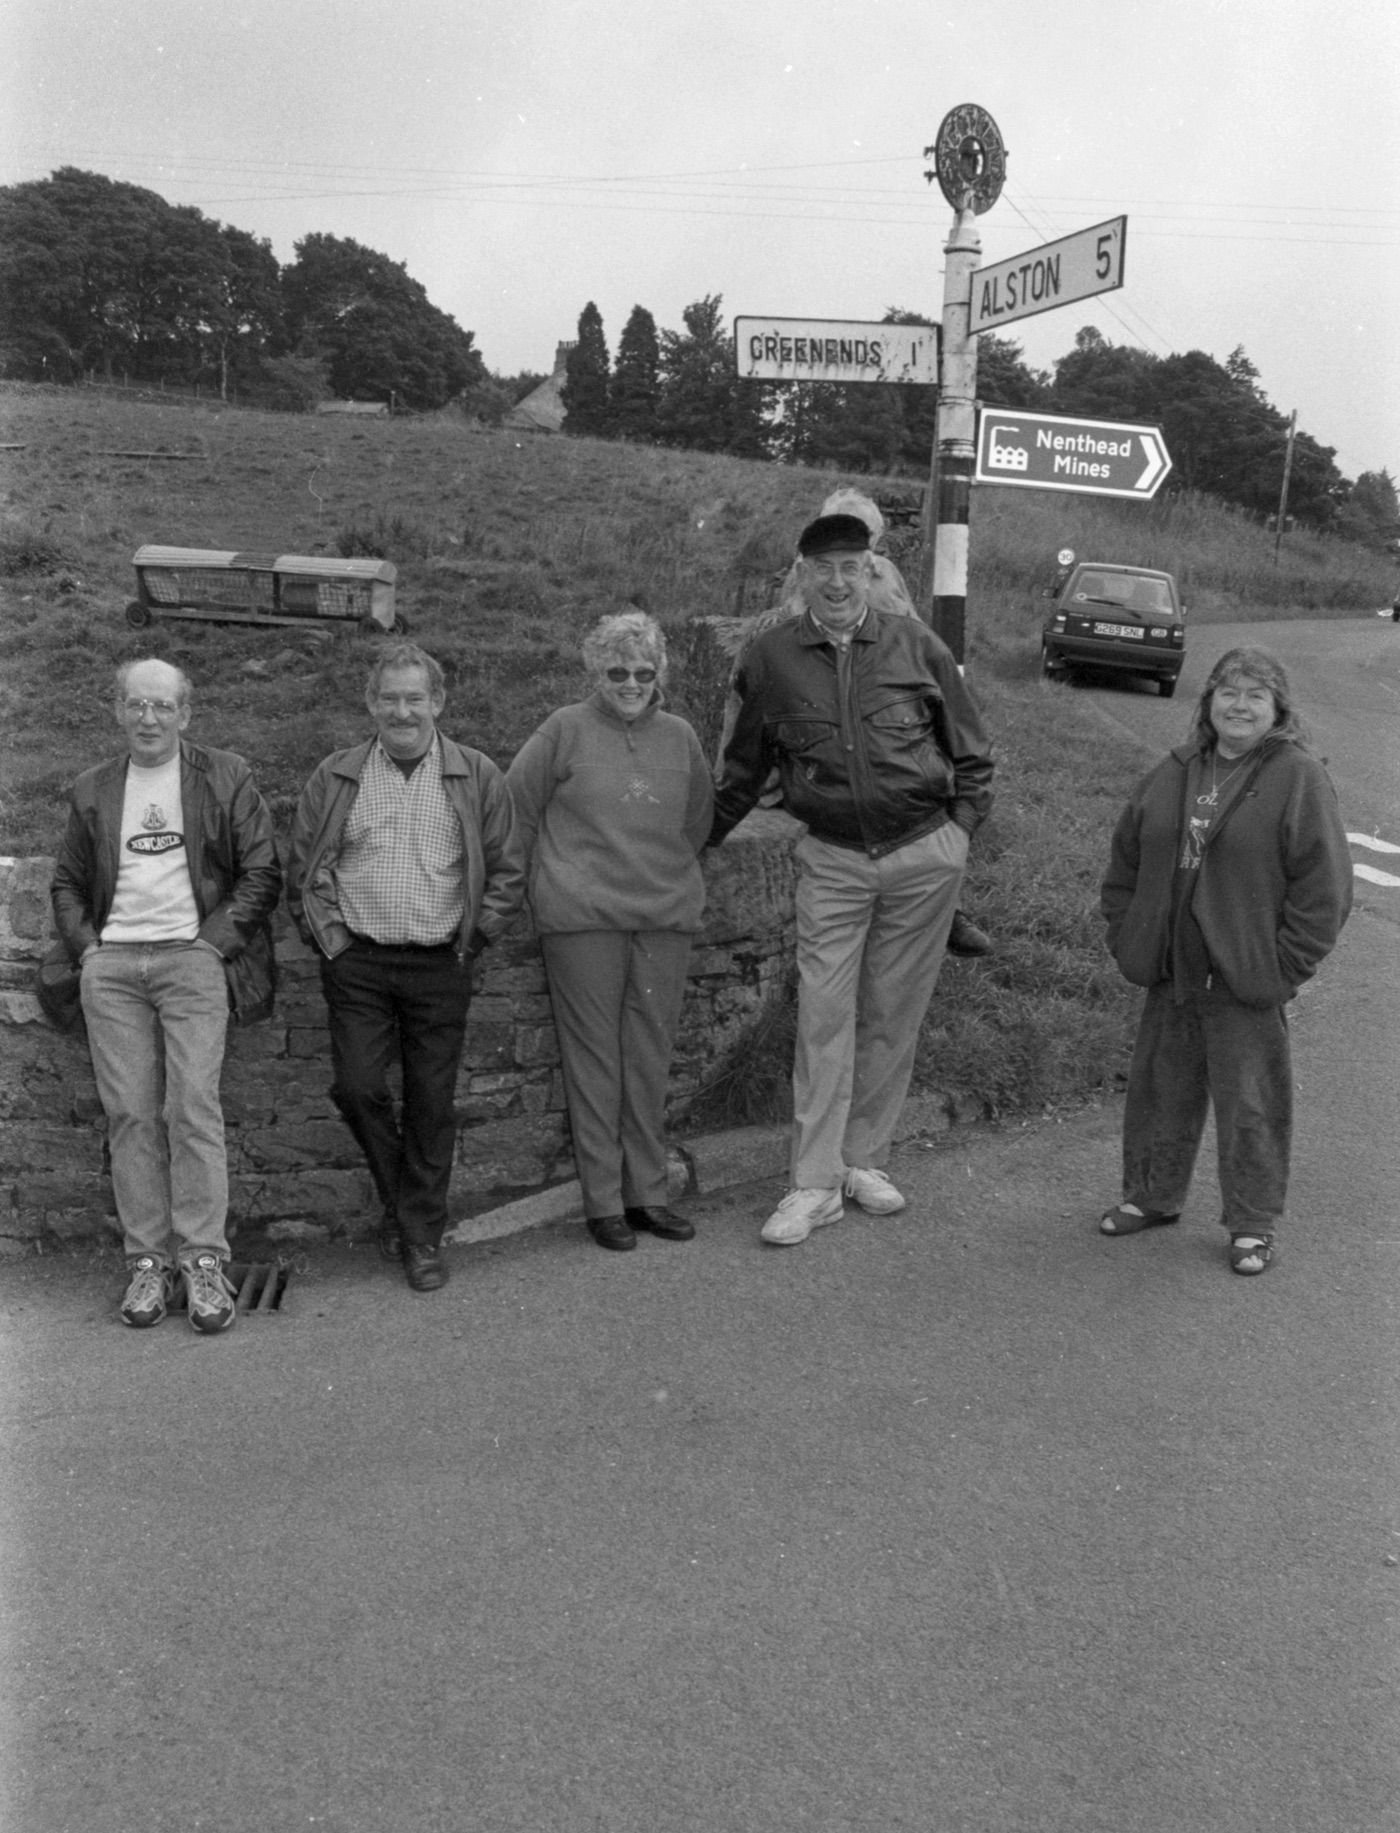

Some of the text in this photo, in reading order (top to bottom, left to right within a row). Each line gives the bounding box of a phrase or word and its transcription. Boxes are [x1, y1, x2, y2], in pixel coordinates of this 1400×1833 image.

[980, 233, 1112, 320] ALSTON 5
[750, 335, 882, 367] GREENENDS
[1036, 429, 1132, 457] Nenthead
[1054, 455, 1111, 478] Mines
[1060, 552, 1073, 561] 30
[1096, 623, 1121, 634] G269
